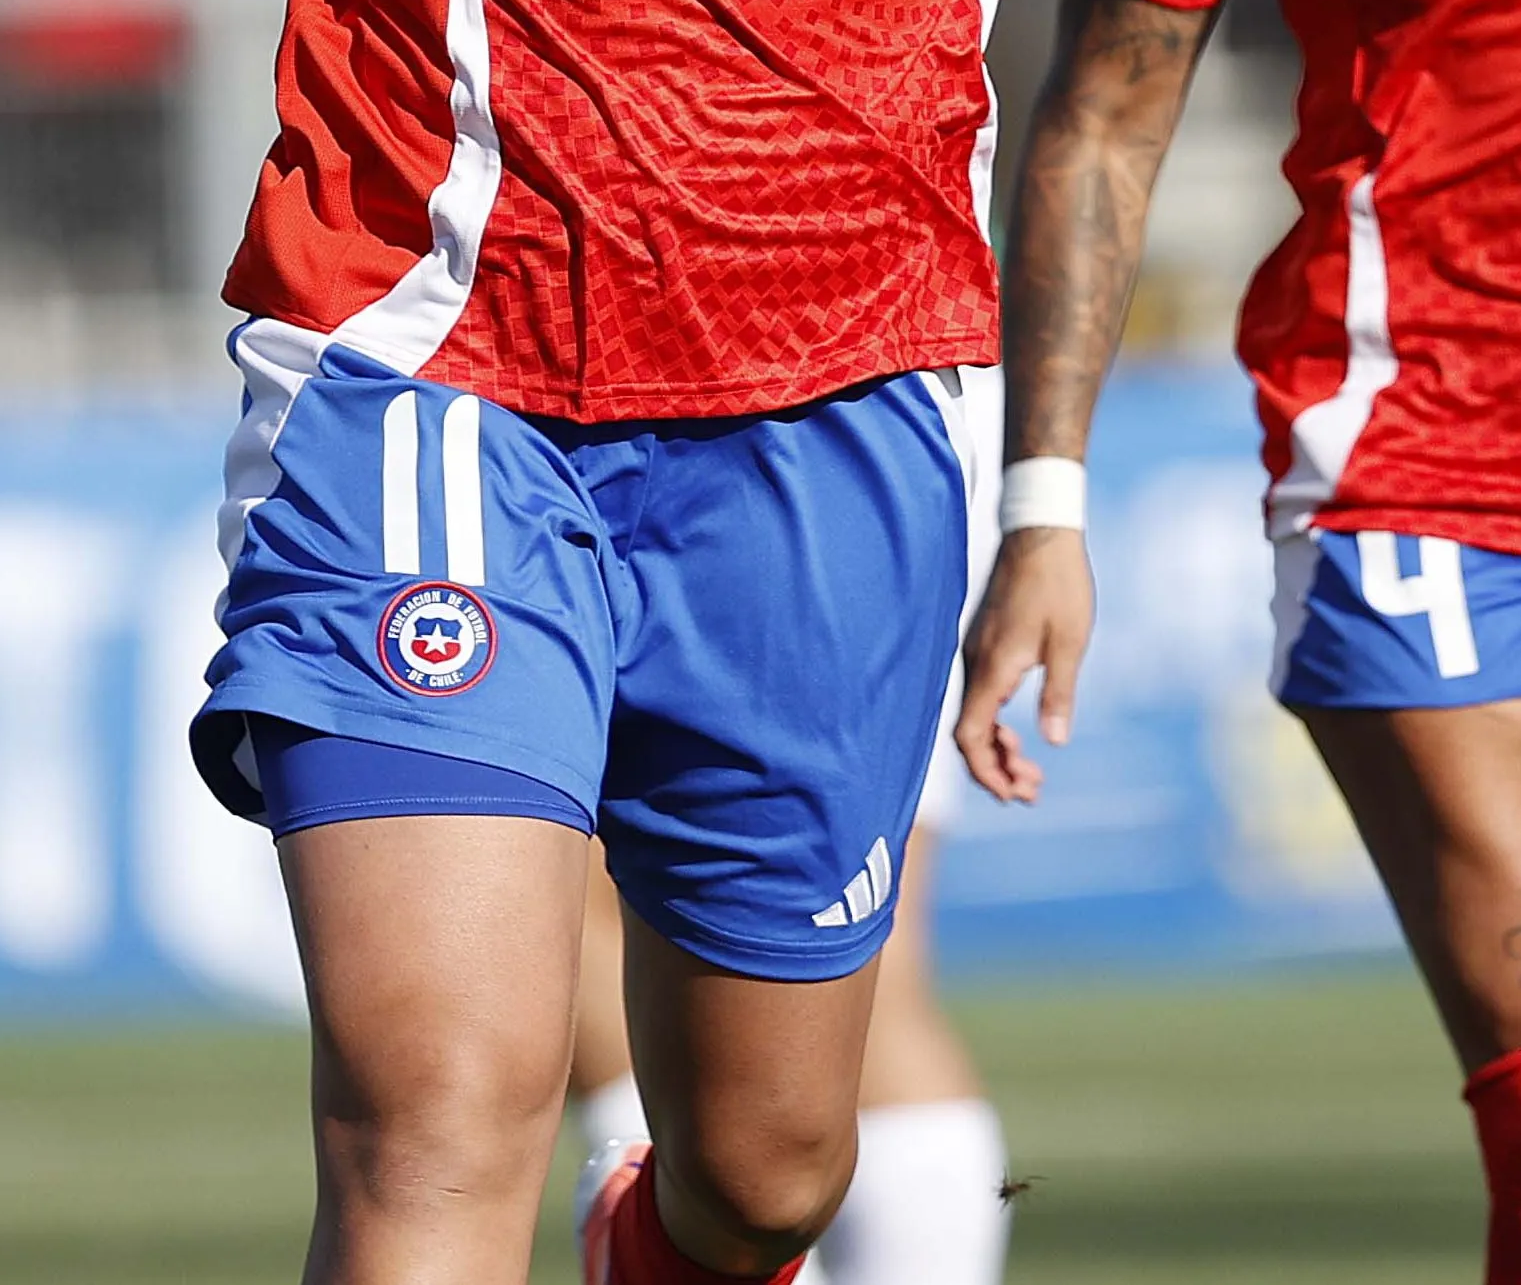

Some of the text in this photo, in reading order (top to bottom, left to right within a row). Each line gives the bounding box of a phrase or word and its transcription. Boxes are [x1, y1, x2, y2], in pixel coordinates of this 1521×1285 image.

[382, 389, 486, 587] 11
[448, 593, 463, 607] DE
[463, 605, 488, 645] FUTBOL
[408, 671, 461, 687] DE CHILE
